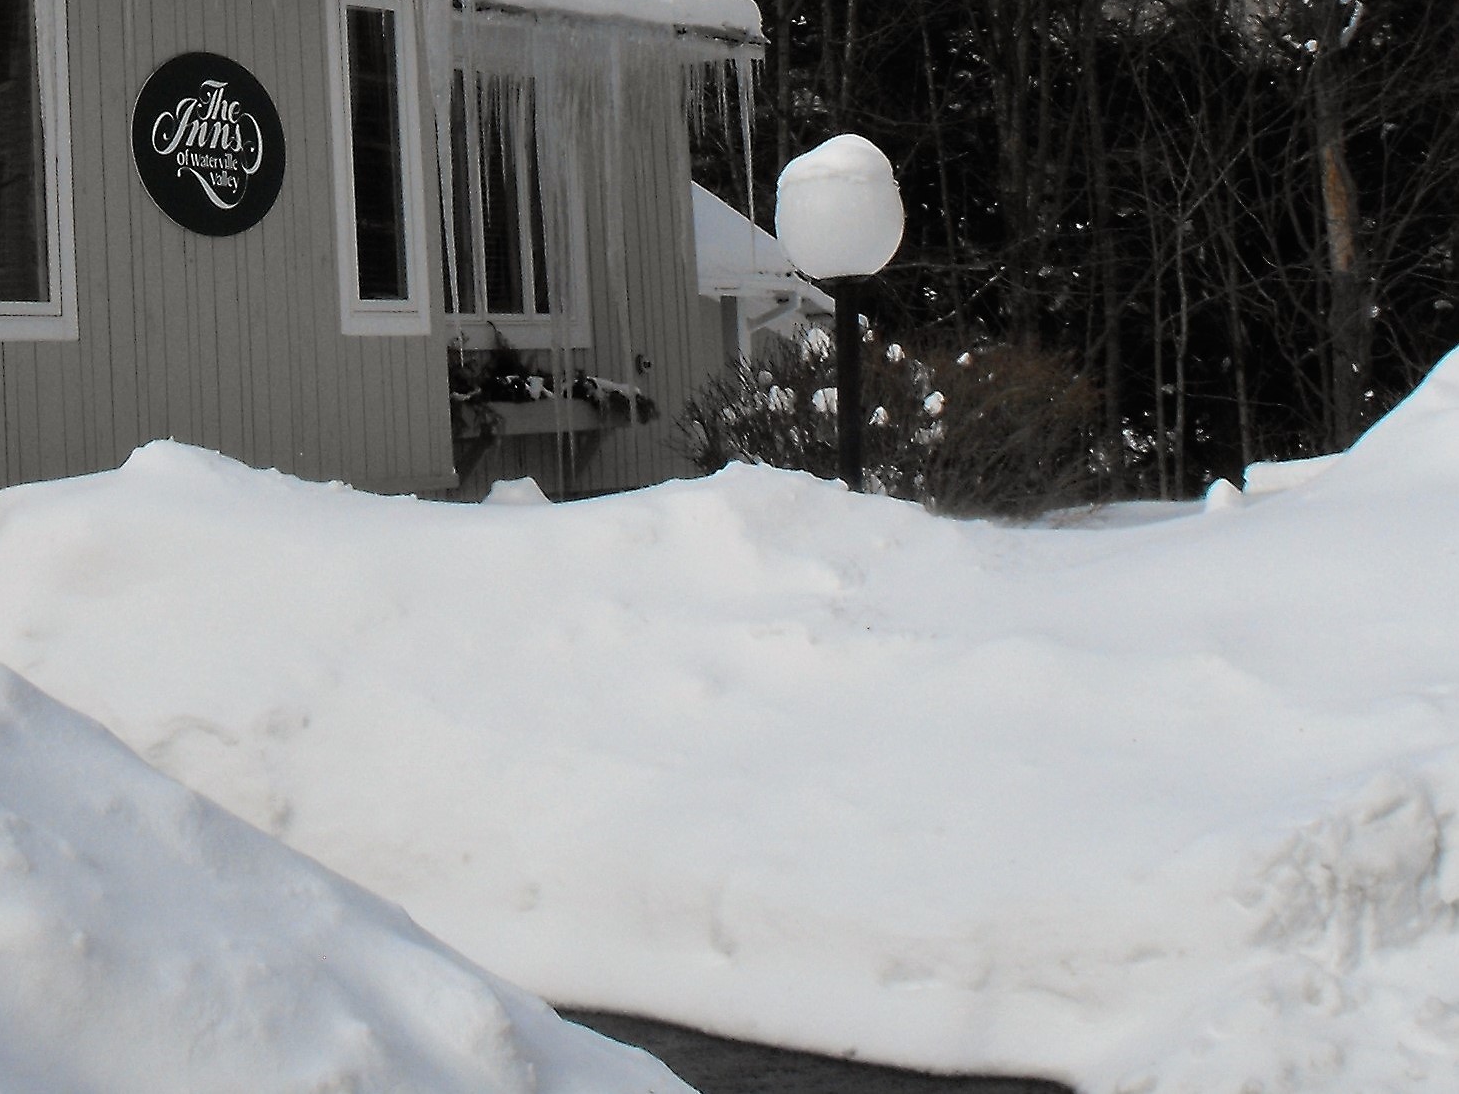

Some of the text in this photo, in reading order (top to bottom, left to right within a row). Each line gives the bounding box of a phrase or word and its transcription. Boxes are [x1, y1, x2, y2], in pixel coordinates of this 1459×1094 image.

[198, 79, 241, 123] The
[152, 97, 244, 155] Inns
[209, 170, 239, 194] Valley
